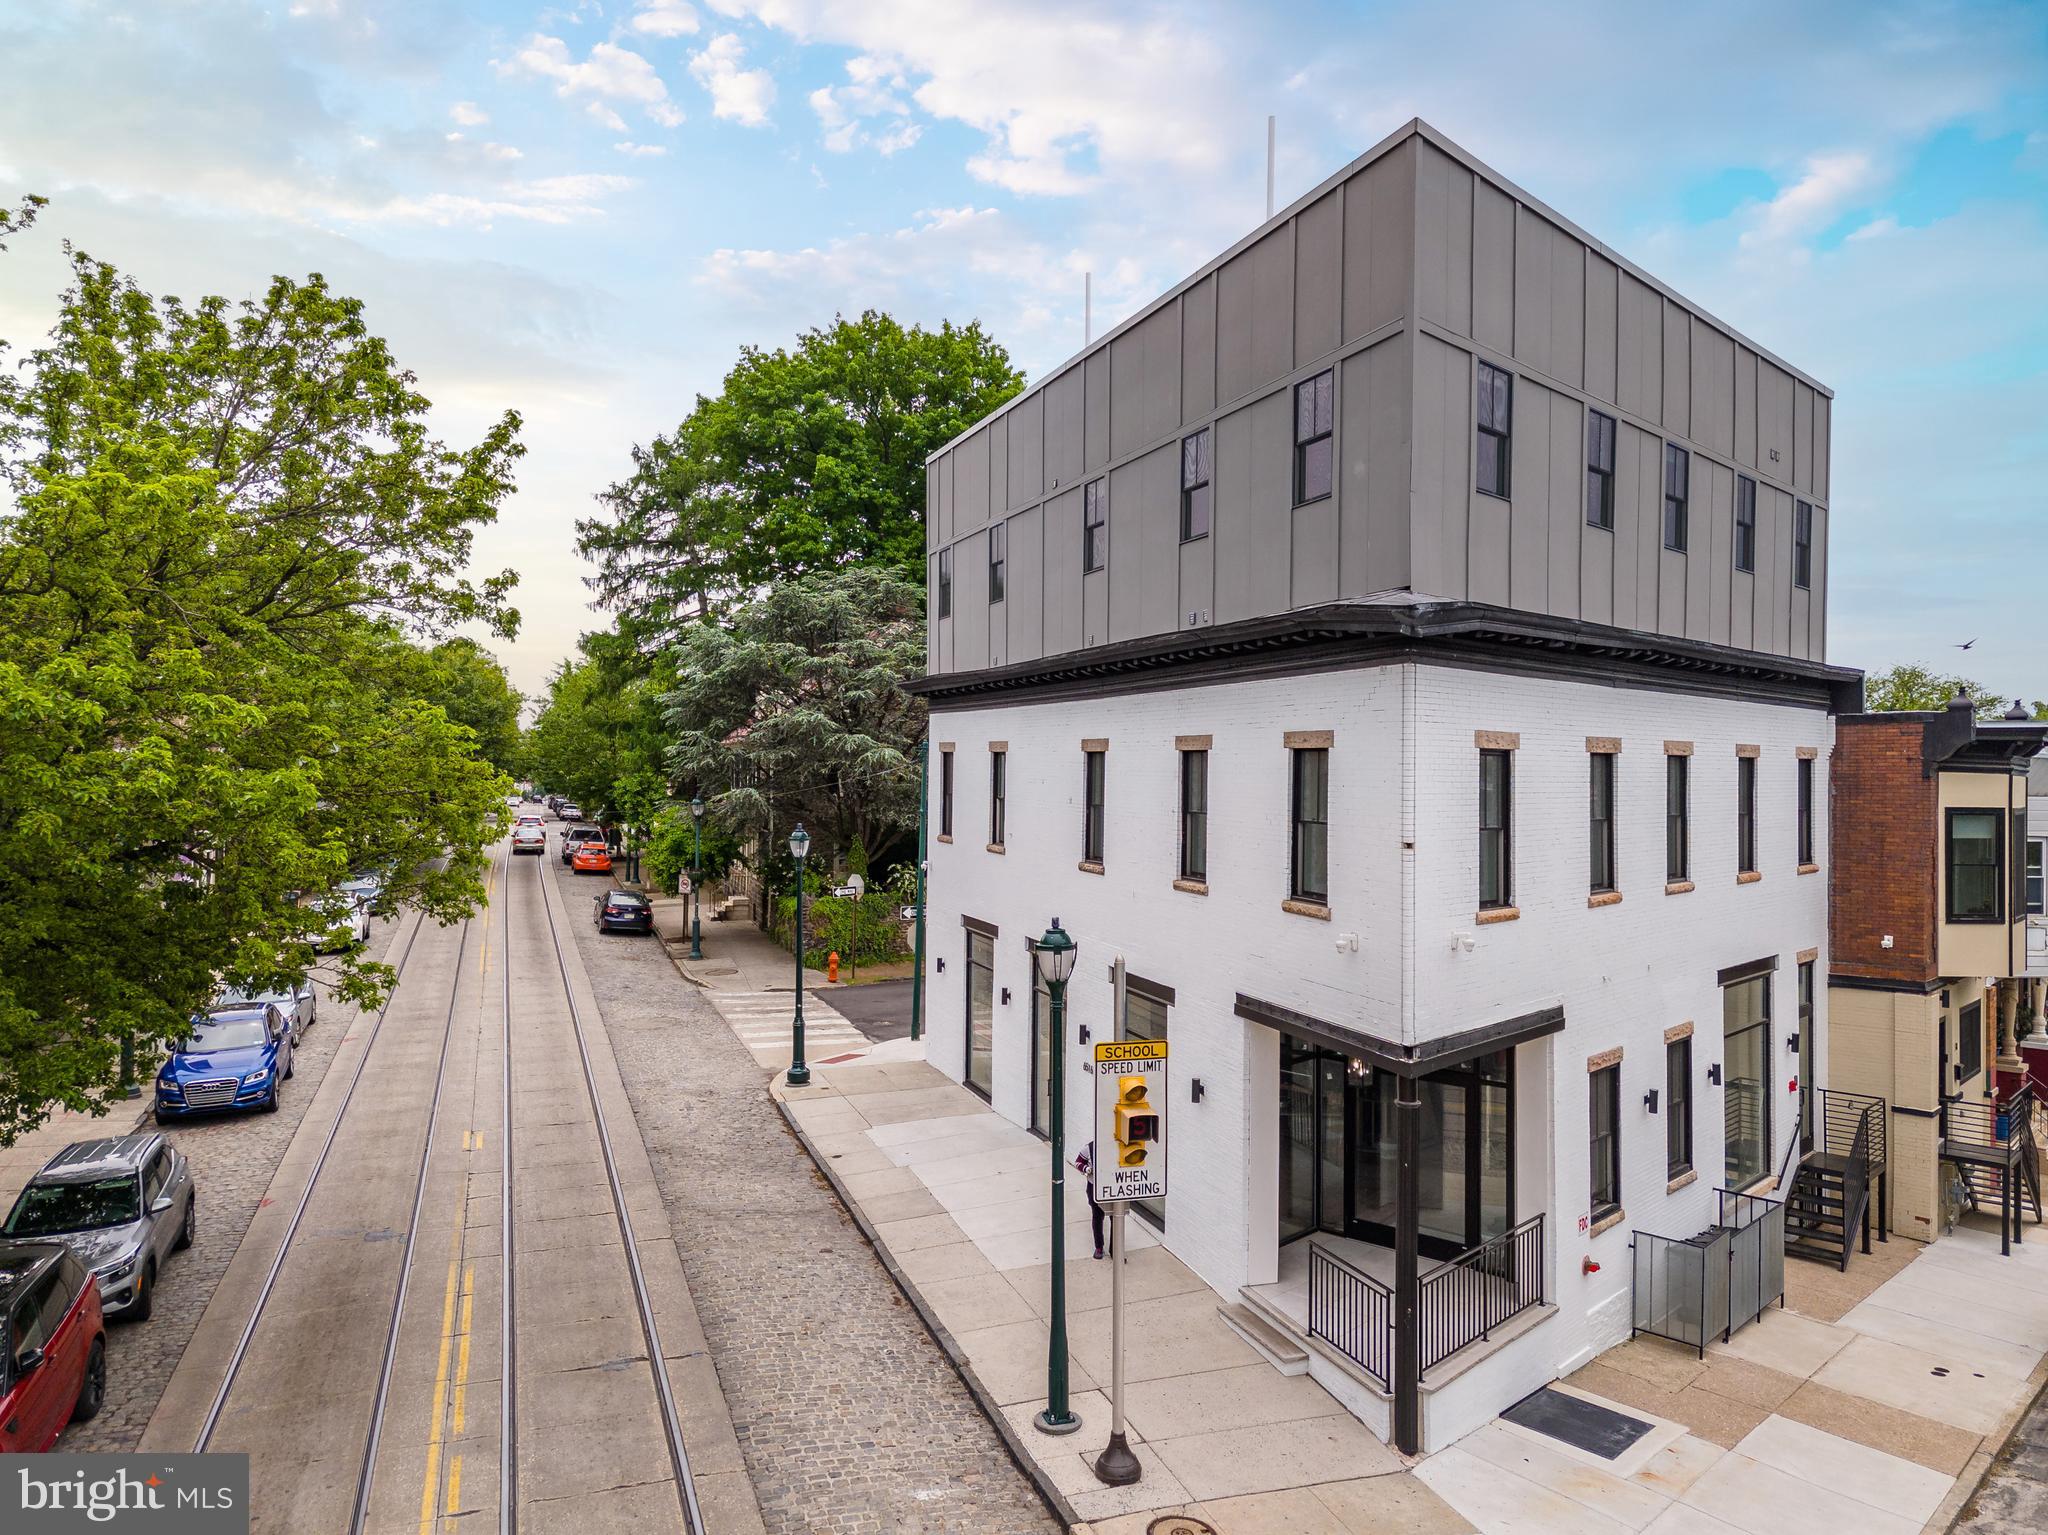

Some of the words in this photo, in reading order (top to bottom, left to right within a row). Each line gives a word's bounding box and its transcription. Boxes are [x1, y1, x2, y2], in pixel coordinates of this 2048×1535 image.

[1105, 1045, 1159, 1059] SCHOOL
[1101, 1061, 1133, 1075] SPEED
[1138, 1060, 1162, 1073] LIMIT
[1115, 1170, 1148, 1184] WHEN
[1102, 1183, 1160, 1198] FLASHING
[1578, 1215, 1589, 1233] FDC
